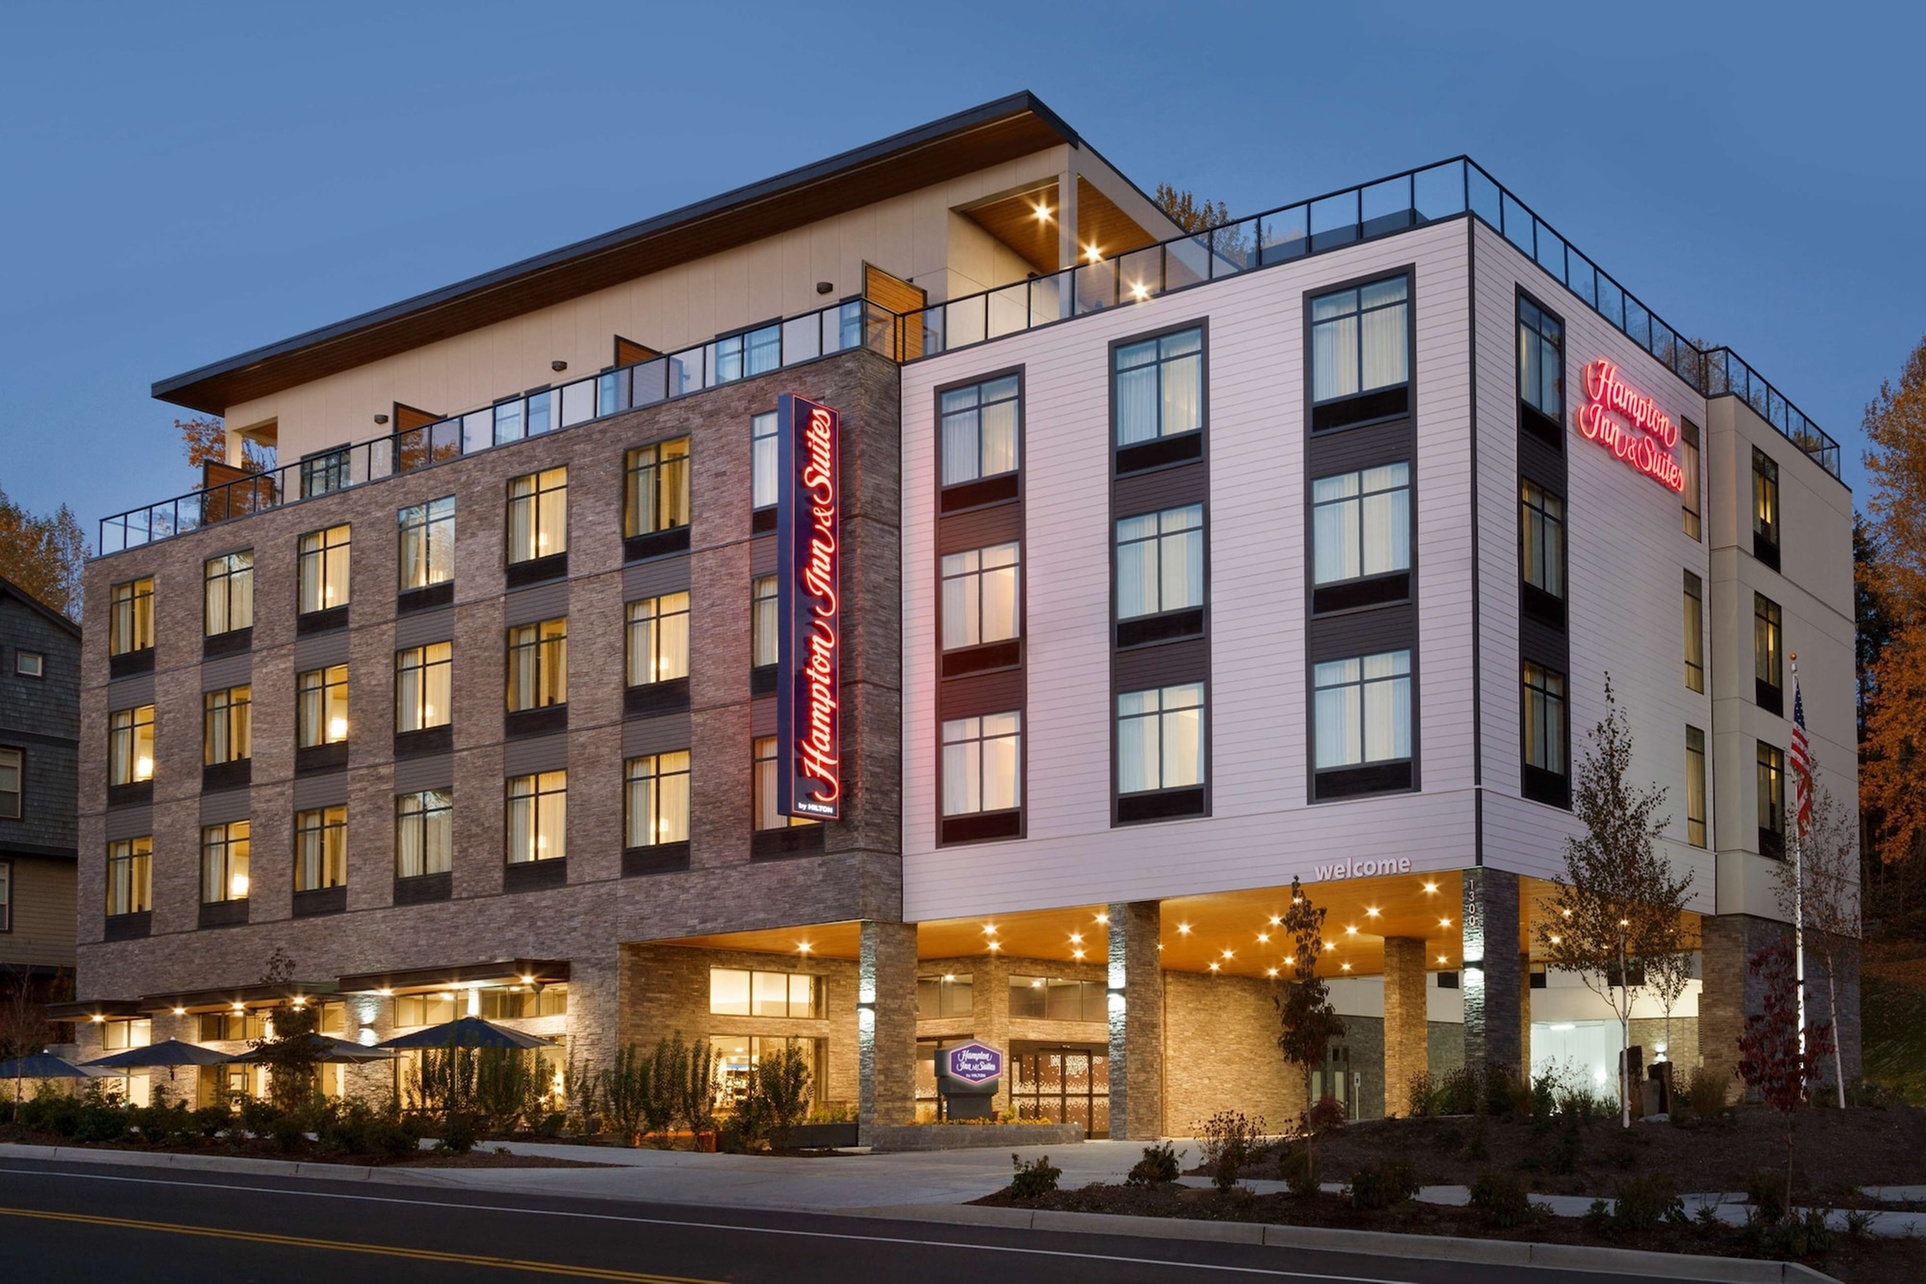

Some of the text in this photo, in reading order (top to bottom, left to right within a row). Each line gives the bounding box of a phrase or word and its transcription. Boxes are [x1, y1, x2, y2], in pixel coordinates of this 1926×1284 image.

[1584, 359, 1678, 449] Hampton
[803, 408, 834, 505] Suites
[1579, 402, 1628, 458] Inn
[1637, 435, 1684, 492] Suites
[804, 524, 837, 617] Inn
[801, 619, 839, 802] Hampton
[798, 802, 834, 814] by HILTON
[1314, 856, 1412, 881] welcome
[1467, 879, 1476, 927] 1300
[956, 1061, 974, 1072] Inn
[979, 1061, 996, 1072] Suites
[957, 1050, 993, 1062] Hampton
